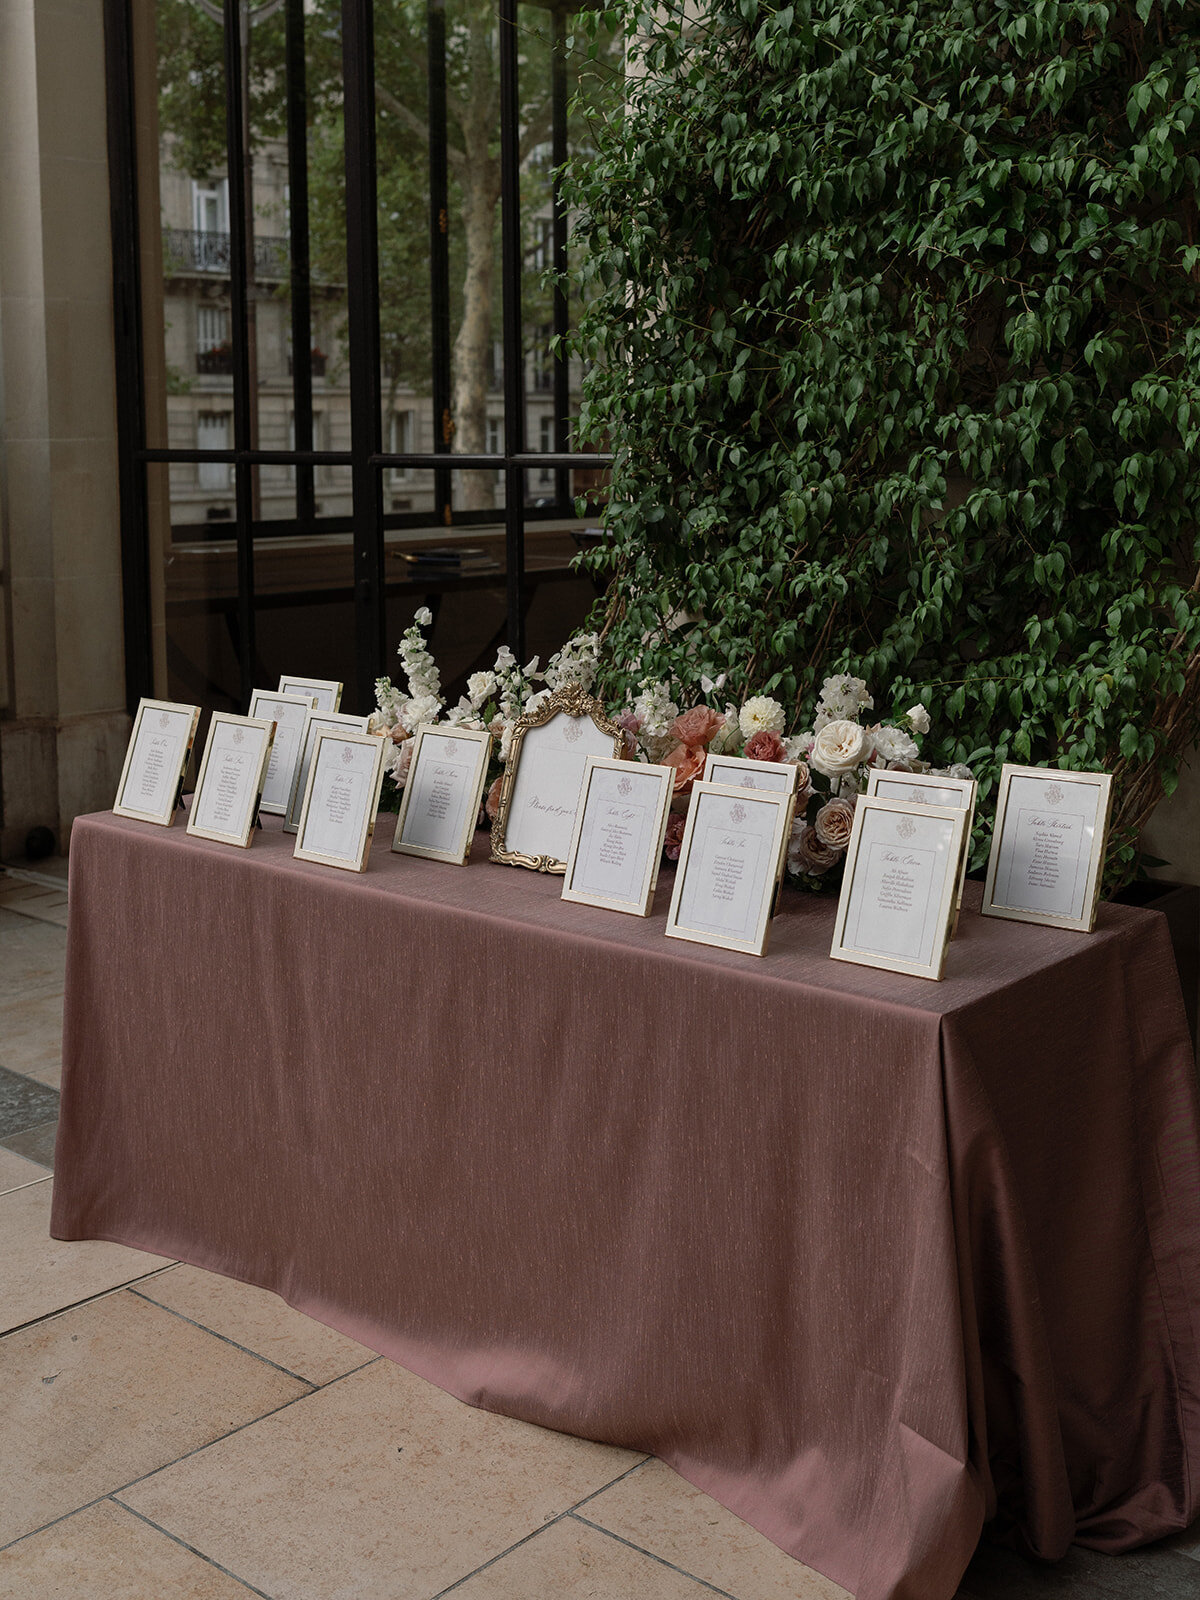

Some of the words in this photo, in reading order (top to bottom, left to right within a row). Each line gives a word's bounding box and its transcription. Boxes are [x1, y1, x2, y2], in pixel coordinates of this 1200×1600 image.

[528, 795, 546, 810] Please
[1027, 815, 1045, 827] Table
[720, 834, 735, 846] Table
[880, 850, 899, 863] Table
